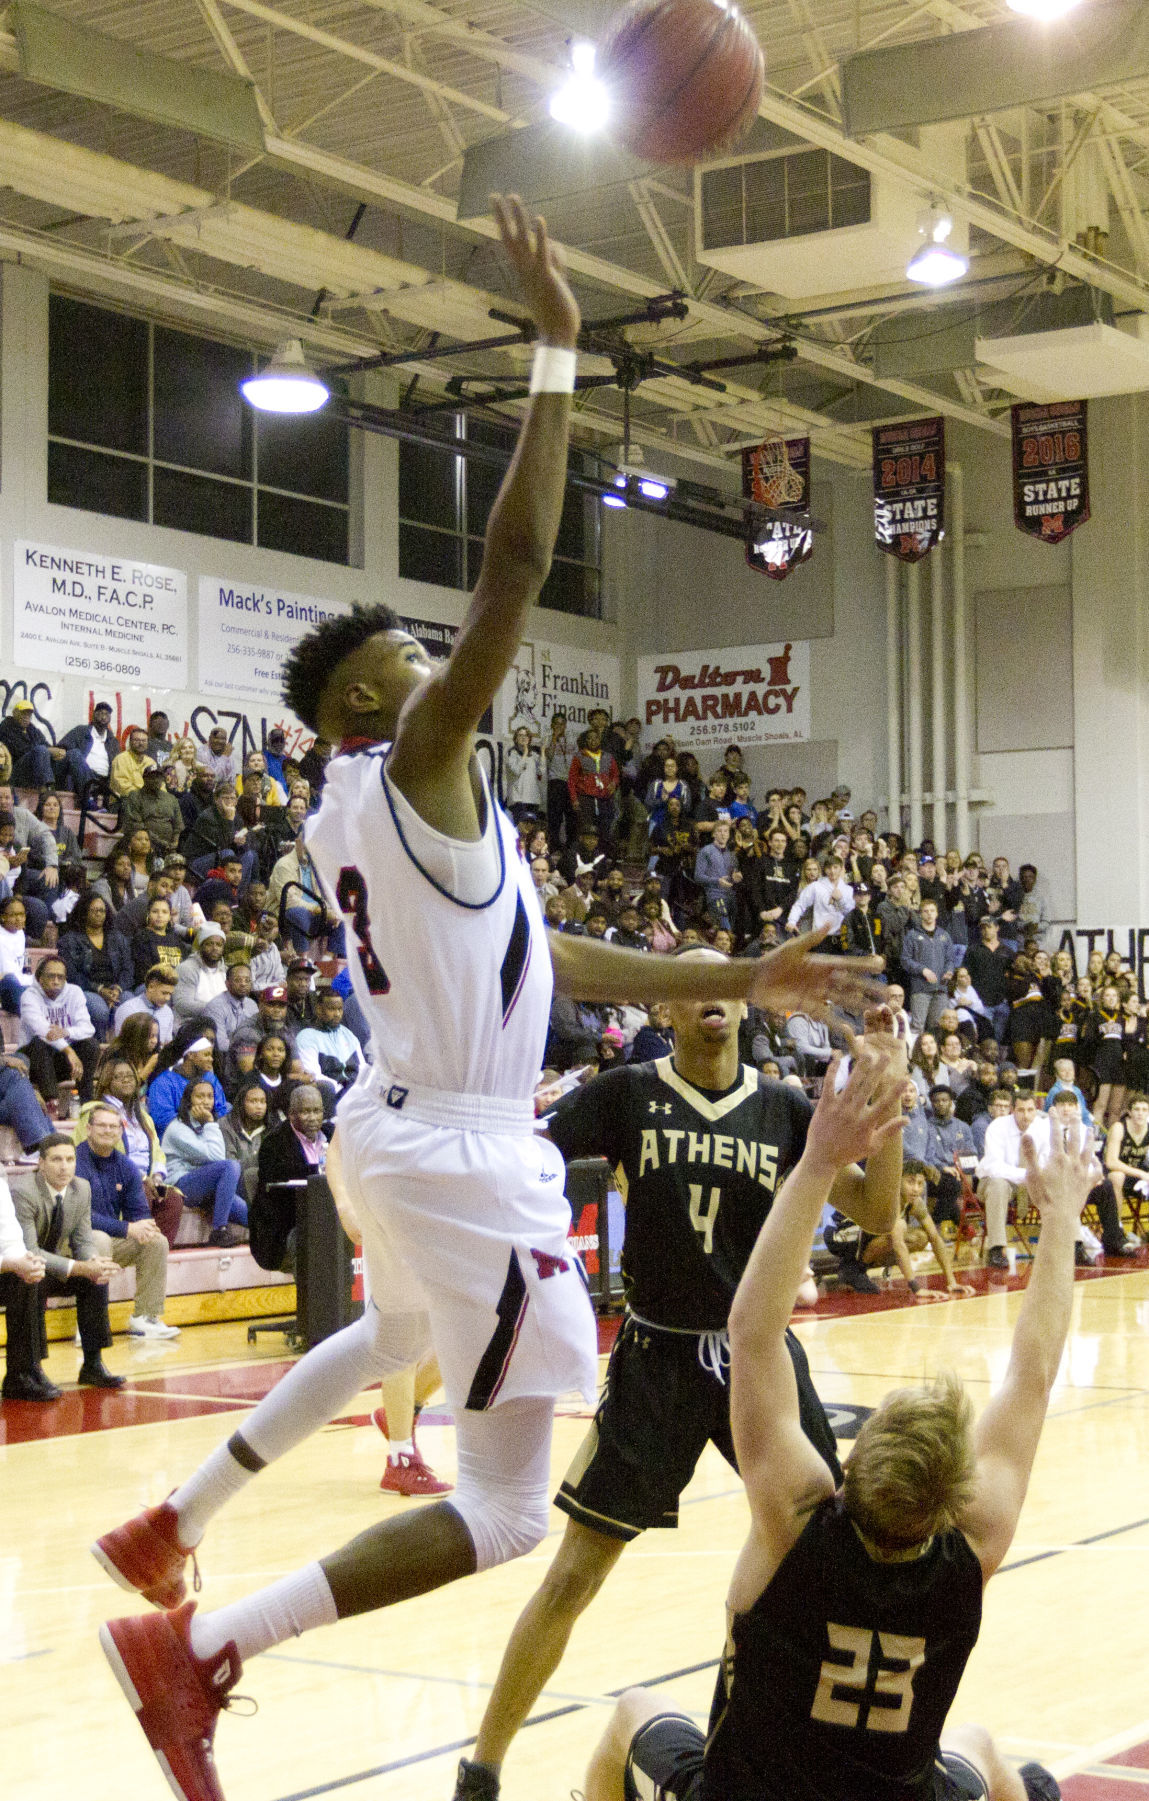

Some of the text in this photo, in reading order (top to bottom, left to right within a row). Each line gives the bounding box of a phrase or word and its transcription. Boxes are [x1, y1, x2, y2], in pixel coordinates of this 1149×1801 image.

[1023, 432, 1080, 466] 2016
[882, 454, 936, 487] 2014
[1023, 478, 1080, 502] STATE
[884, 498, 937, 520] STATE
[1026, 498, 1079, 516] RUNNER UP
[890, 518, 937, 534] HAMPIONS
[1042, 514, 1064, 534] M
[26, 549, 178, 593] KENNETH E. ROSE,
[52, 577, 154, 611] M.D., F.A.C.P.
[219, 588, 272, 615] Mack's
[25, 601, 66, 616] AVALON
[69, 608, 114, 626] MEDICAL
[116, 616, 159, 634] CENTER,
[61, 622, 145, 643] INTERNAL MEDICINE
[221, 624, 263, 638] Commercial
[264, 630, 269, 639] &
[410, 624, 443, 642] Alabama
[65, 656, 141, 676] (256) 386-0809
[254, 668, 270, 679] Free
[654, 664, 765, 692] Dalton
[541, 664, 609, 700] Franklin
[645, 686, 800, 725] PHARMACY
[690, 721, 756, 736] 256.978.5102
[714, 736, 733, 745] Road
[640, 1130, 779, 1192] ATHENS
[689, 1184, 721, 1254] 4
[810, 1621, 926, 1732] 23
